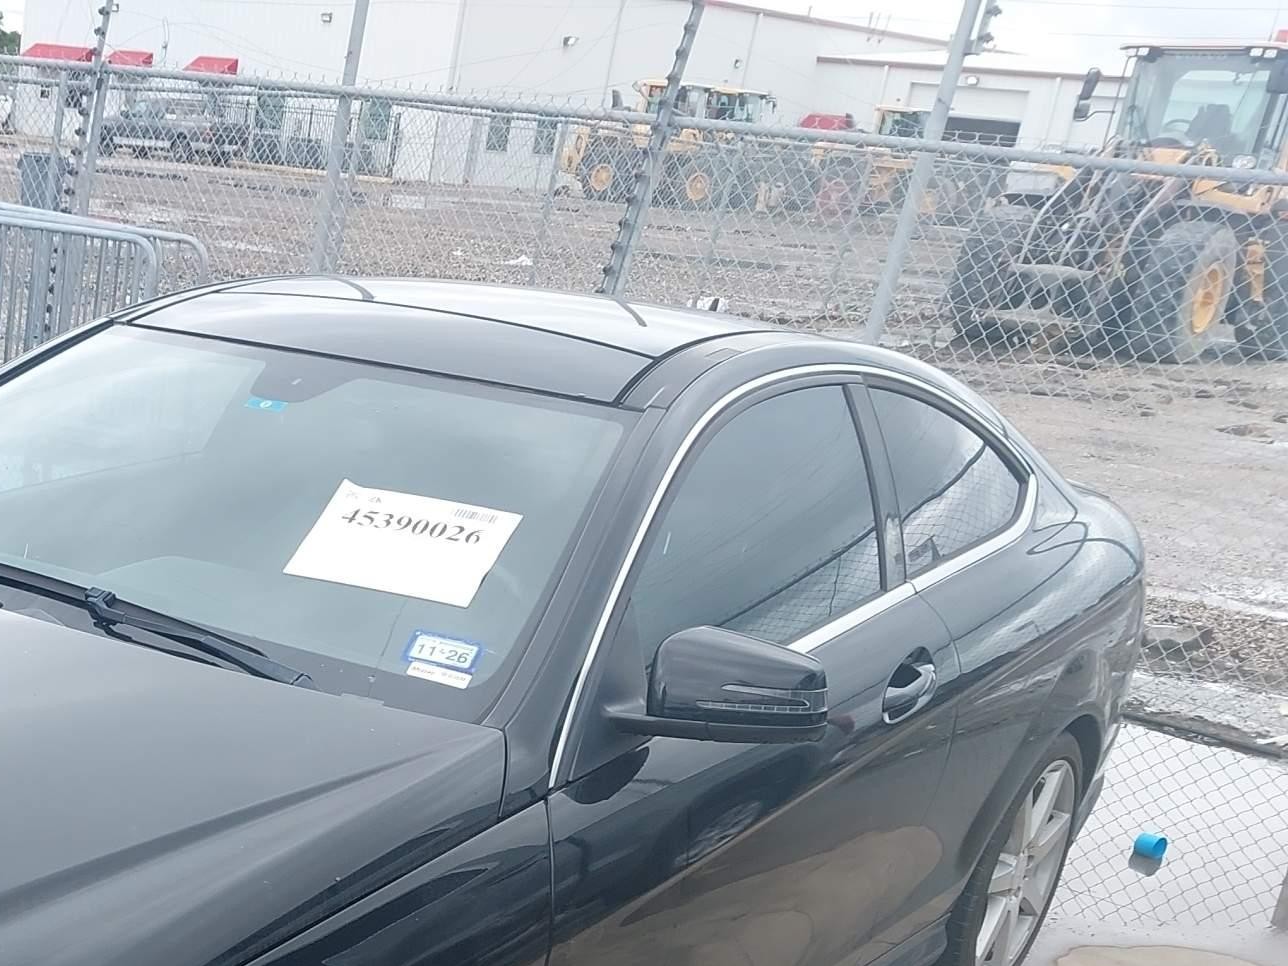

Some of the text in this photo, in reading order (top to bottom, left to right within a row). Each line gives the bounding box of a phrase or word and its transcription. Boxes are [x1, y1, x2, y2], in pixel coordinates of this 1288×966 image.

[341, 508, 485, 545] 45390026
[417, 643, 436, 657] 11
[445, 649, 470, 664] 26
